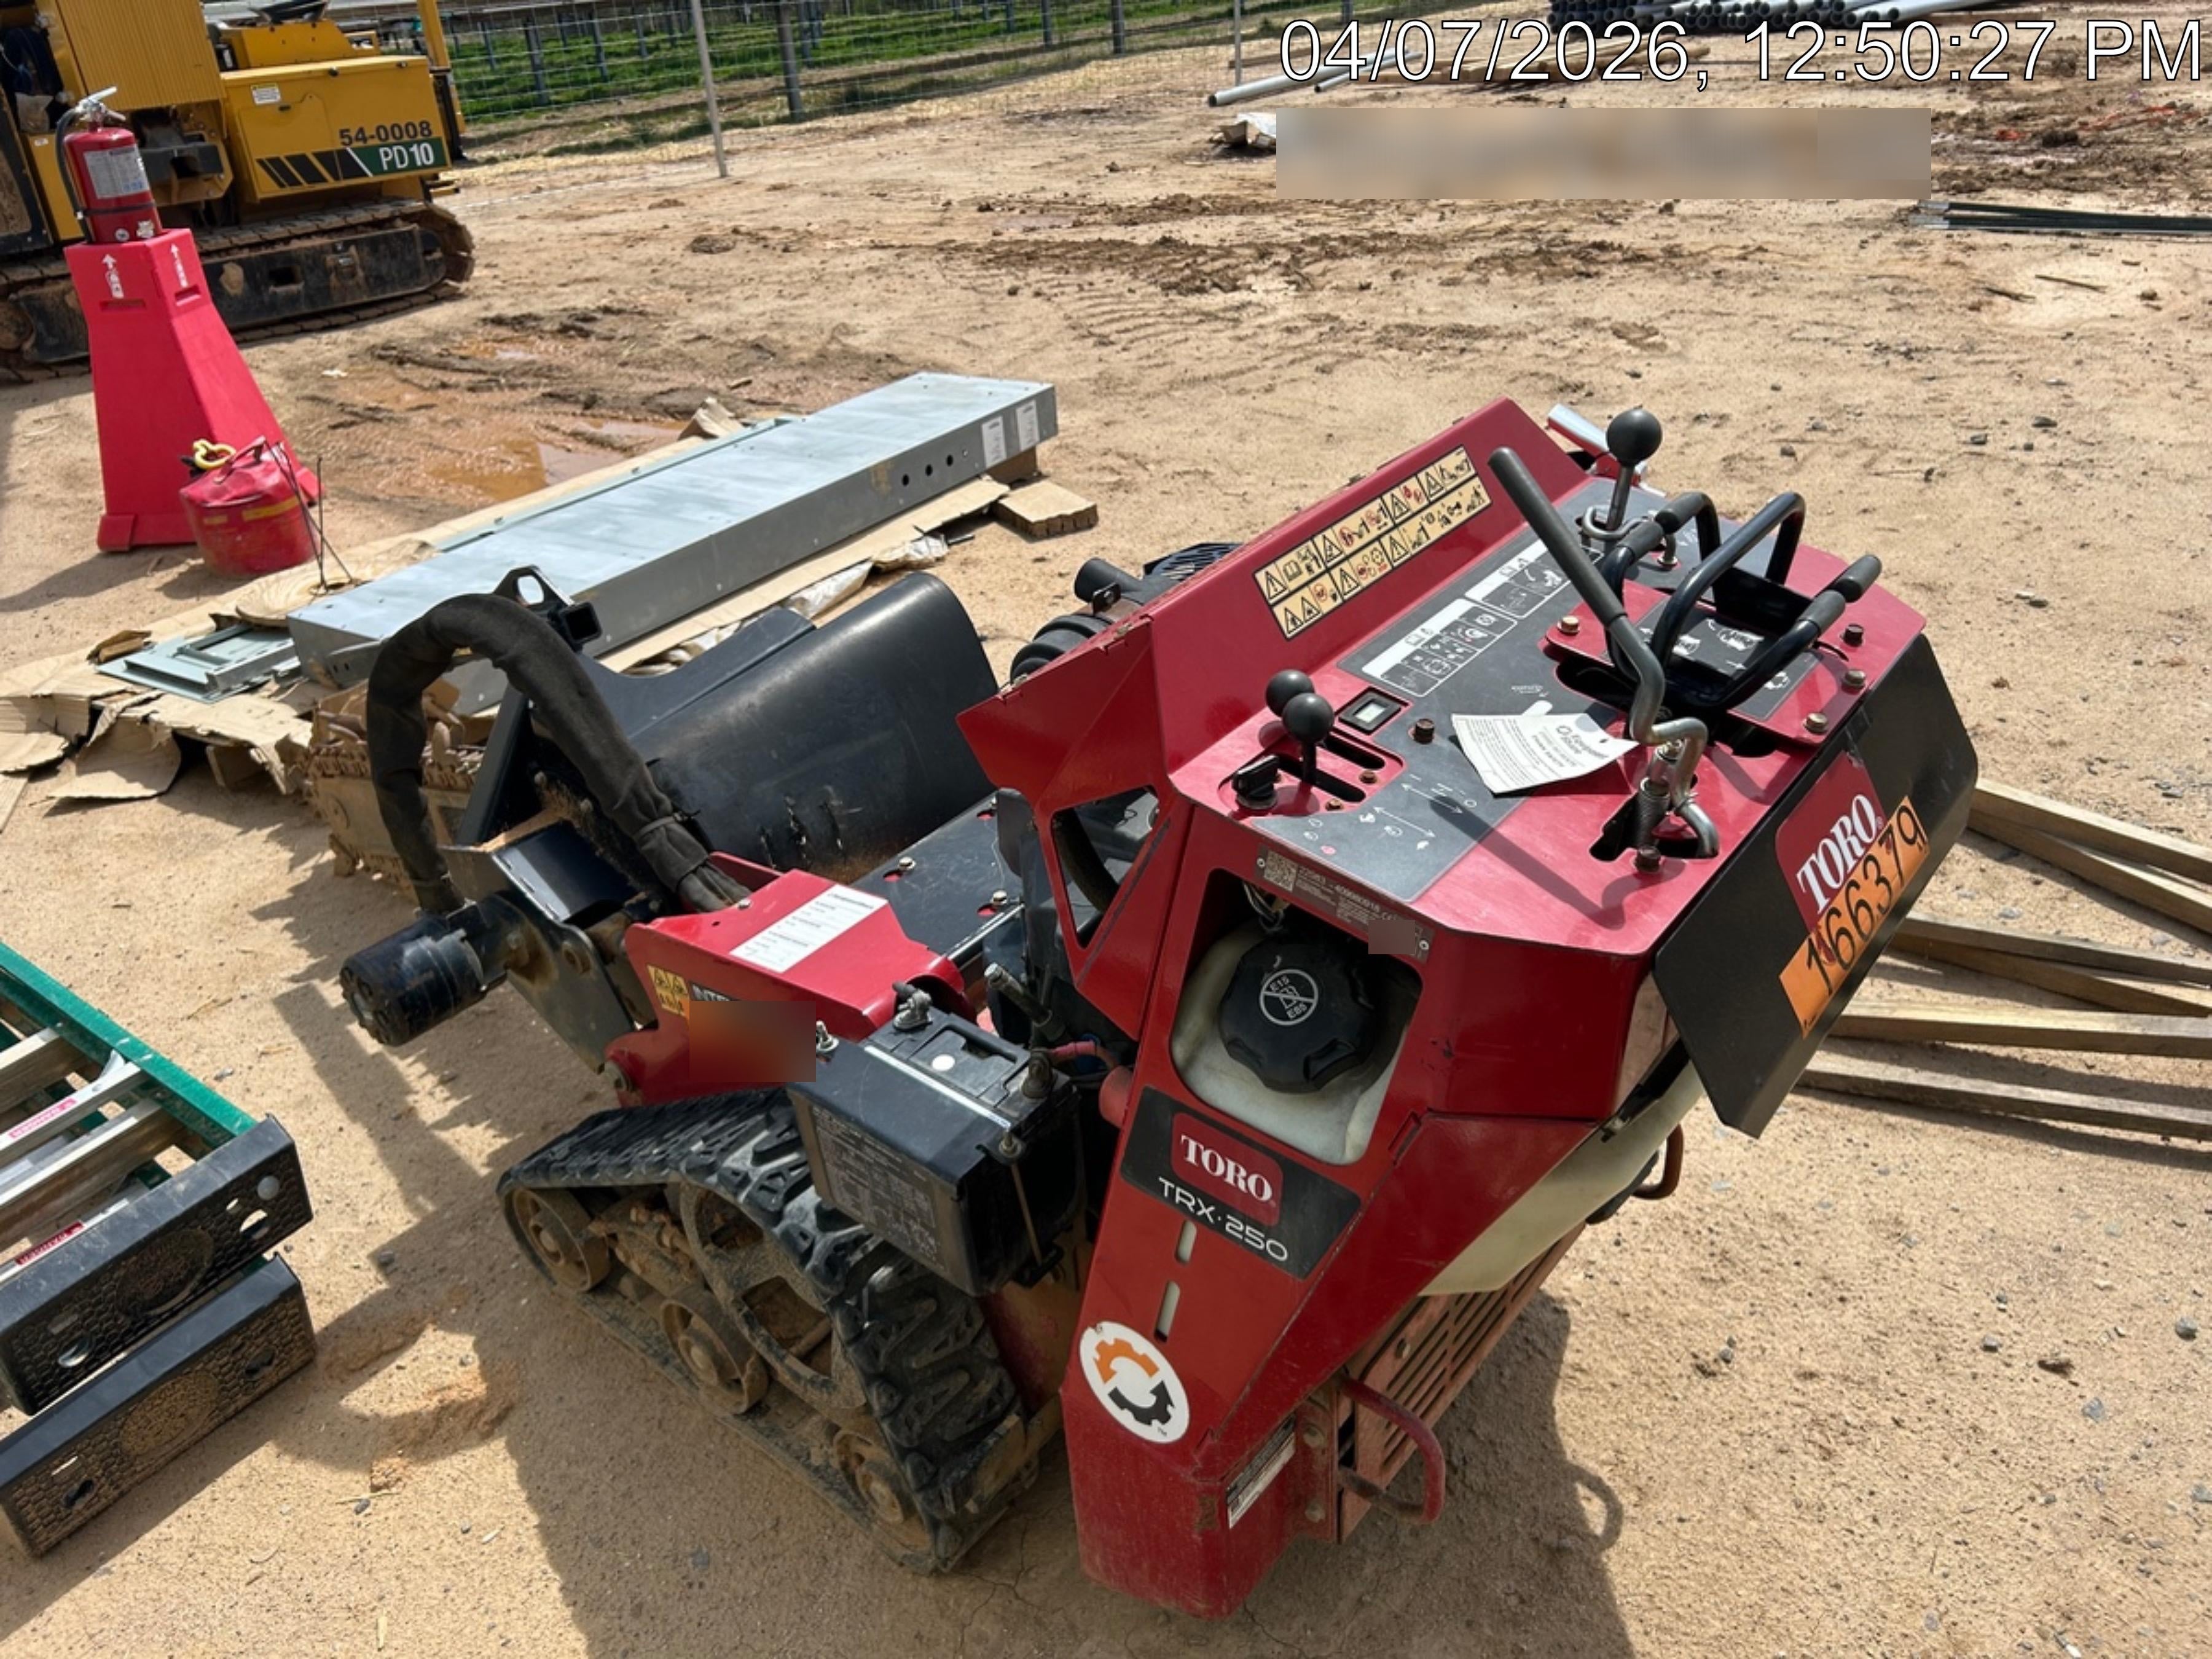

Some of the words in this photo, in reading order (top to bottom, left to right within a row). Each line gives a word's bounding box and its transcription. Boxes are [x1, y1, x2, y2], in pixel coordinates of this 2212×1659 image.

[339, 120, 433, 146] 54-0008
[1796, 794, 1878, 916] TORO
[1805, 804, 1926, 997] 166379
[1180, 1134, 1273, 1202] TORO
